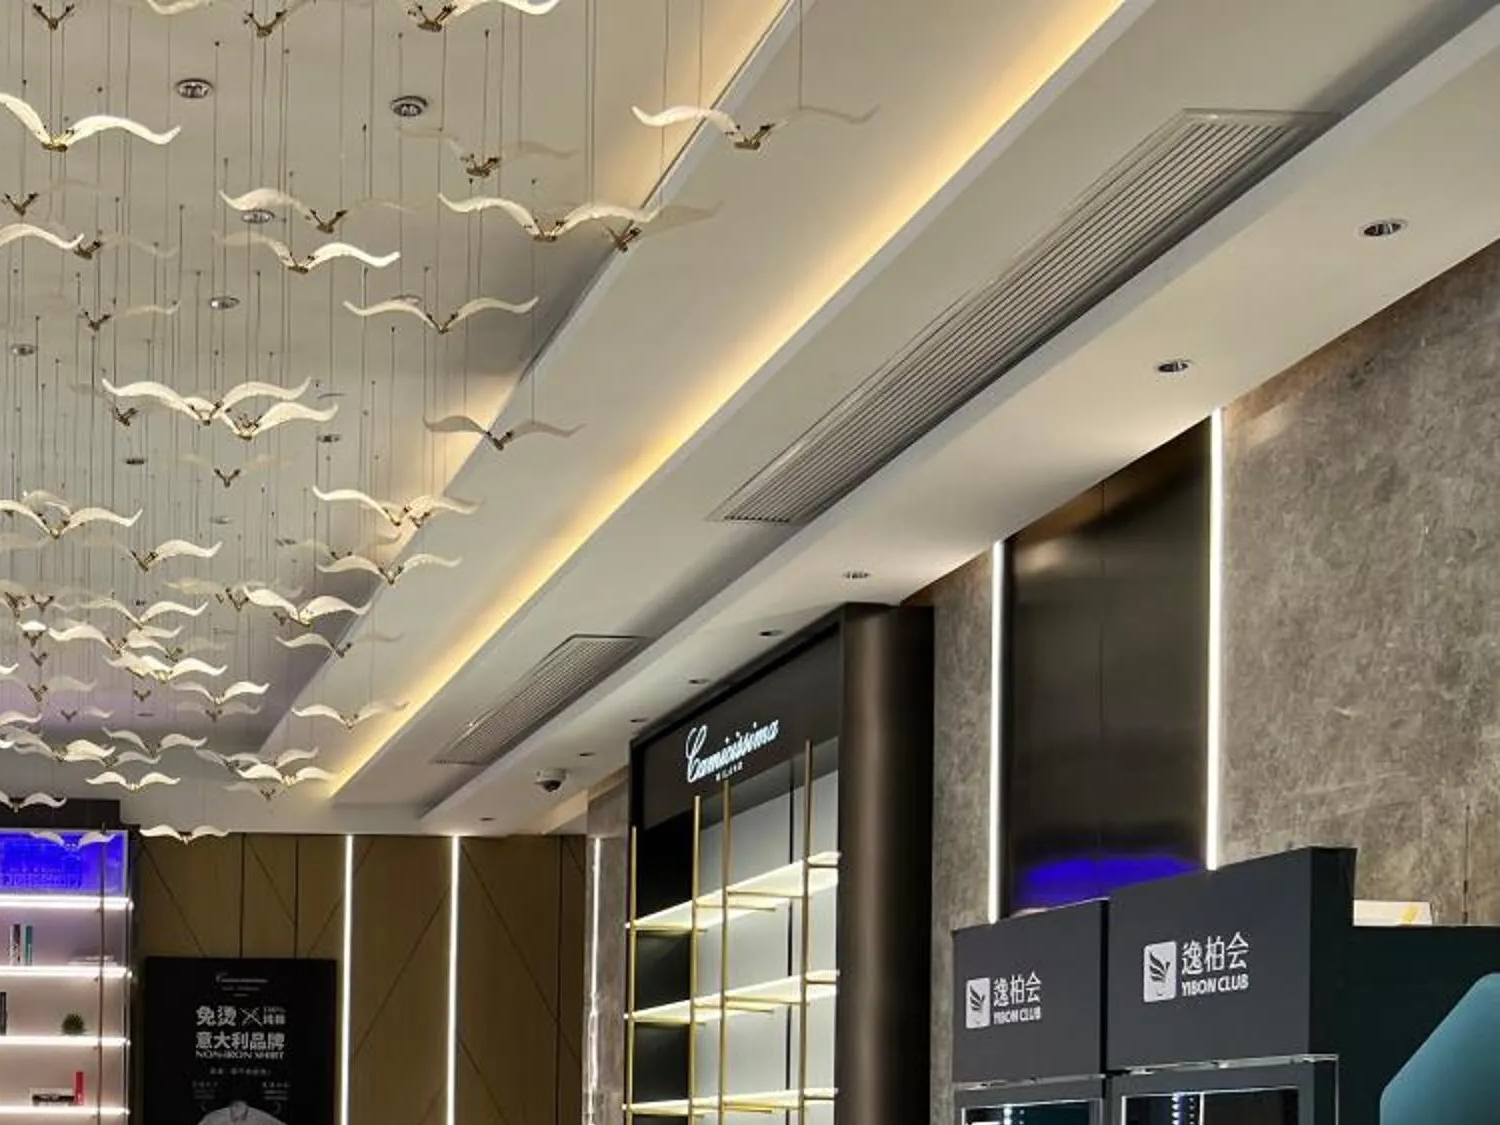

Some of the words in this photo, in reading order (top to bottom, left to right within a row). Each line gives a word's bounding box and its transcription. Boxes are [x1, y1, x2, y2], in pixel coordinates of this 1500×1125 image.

[1181, 931, 1249, 975] 逸柏会
[993, 971, 1042, 1007] 逸柏会
[1182, 978, 1217, 996] YIBON
[1218, 973, 1249, 992] CLUB
[195, 1031, 285, 1050] 意大利品牌
